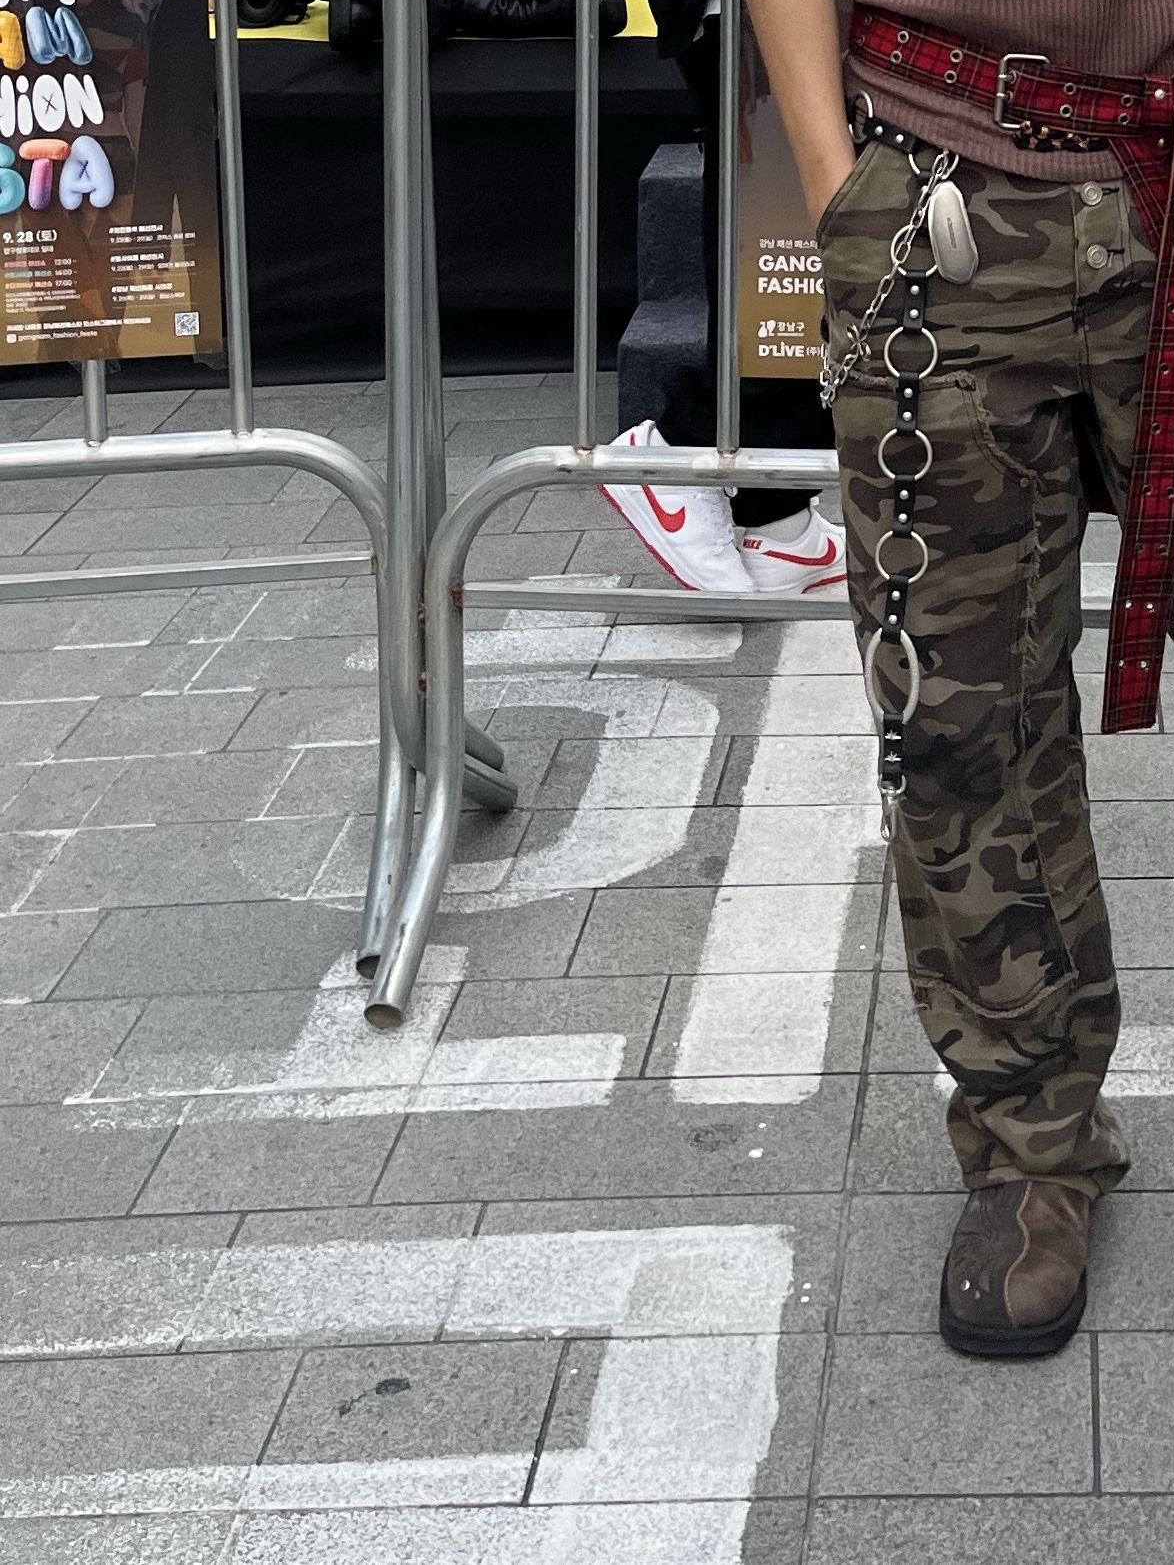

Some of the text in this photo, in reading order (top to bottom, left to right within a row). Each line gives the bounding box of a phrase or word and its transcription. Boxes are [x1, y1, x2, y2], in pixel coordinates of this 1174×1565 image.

[758, 254, 823, 273] GANG
[758, 276, 825, 295] FASHI
[777, 321, 805, 332] 강남구
[742, 538, 762, 549] NIKE
